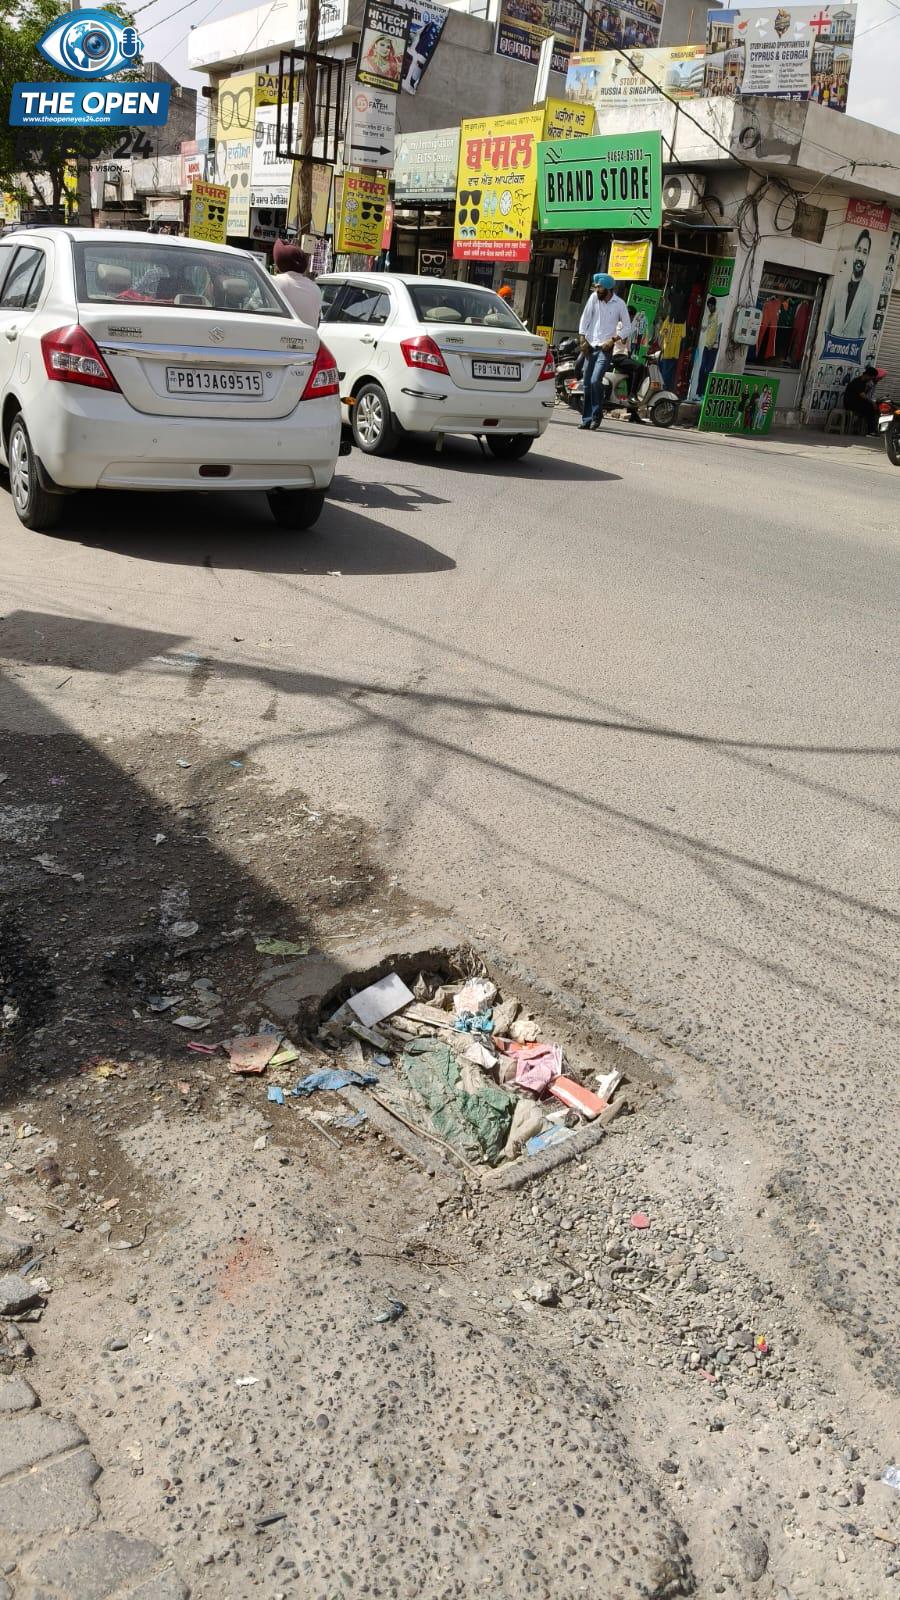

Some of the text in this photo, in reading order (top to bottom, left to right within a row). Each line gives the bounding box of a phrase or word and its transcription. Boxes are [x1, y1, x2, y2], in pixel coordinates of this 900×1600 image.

[368, 9, 408, 28] HI-TECH
[370, 20, 403, 37] SALON
[751, 50, 808, 61] CYPRUS & GEORGIA
[620, 78, 636, 86] STUDY
[600, 87, 622, 96] RUSSIA
[623, 86, 628, 95] &
[547, 166, 649, 202] BRAND STORE
[826, 341, 860, 356] Parmod Sir
[478, 364, 487, 375] PB
[178, 372, 260, 391] PB13AG9515
[709, 376, 742, 397] BRAND
[705, 398, 737, 418] STORE
